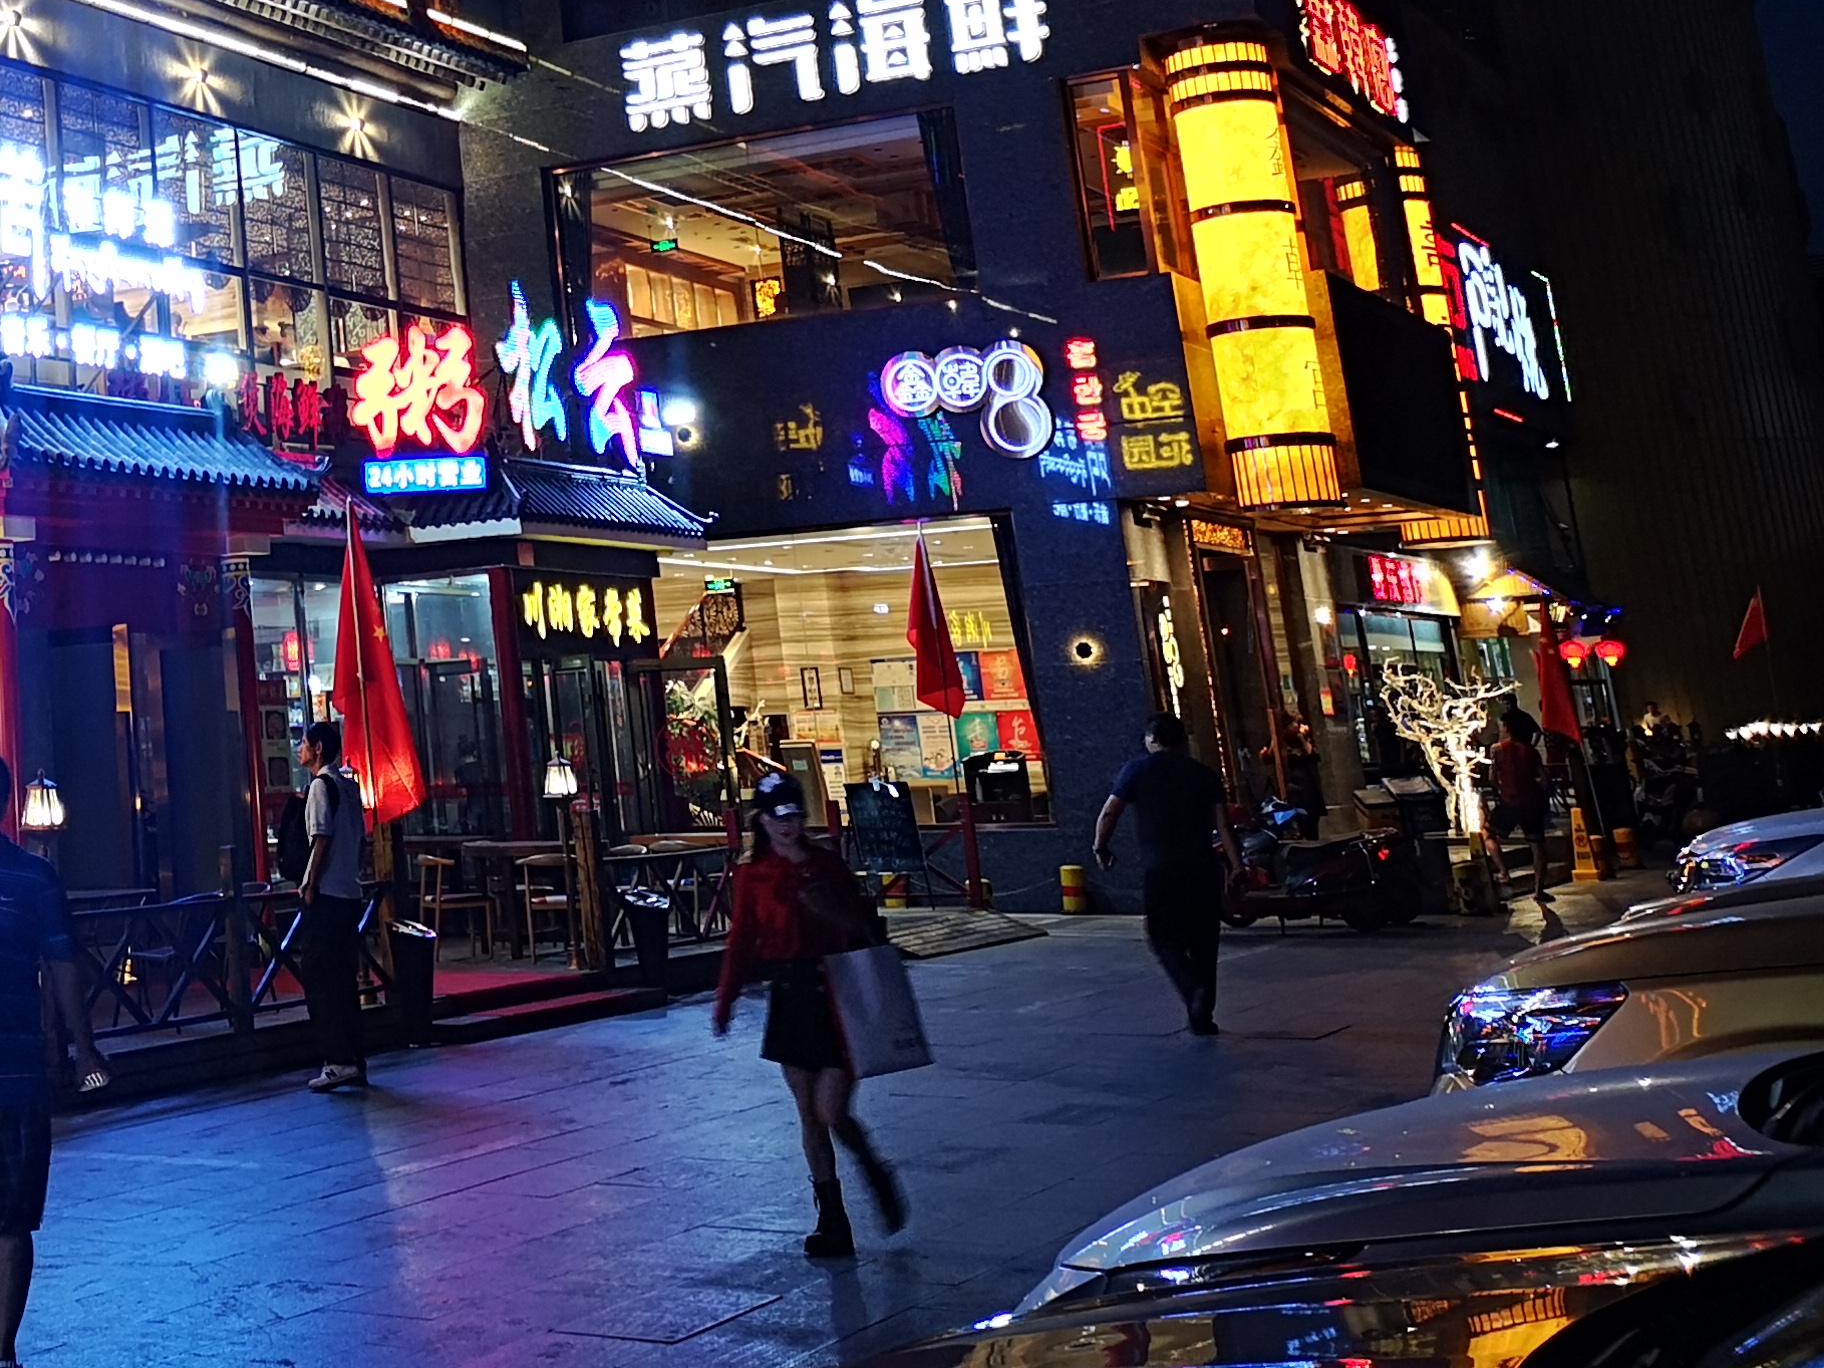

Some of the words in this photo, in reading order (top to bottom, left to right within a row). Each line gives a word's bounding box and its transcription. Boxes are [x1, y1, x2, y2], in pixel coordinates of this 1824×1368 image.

[354, 324, 486, 458] 粥
[367, 461, 483, 490] 24小时营业
